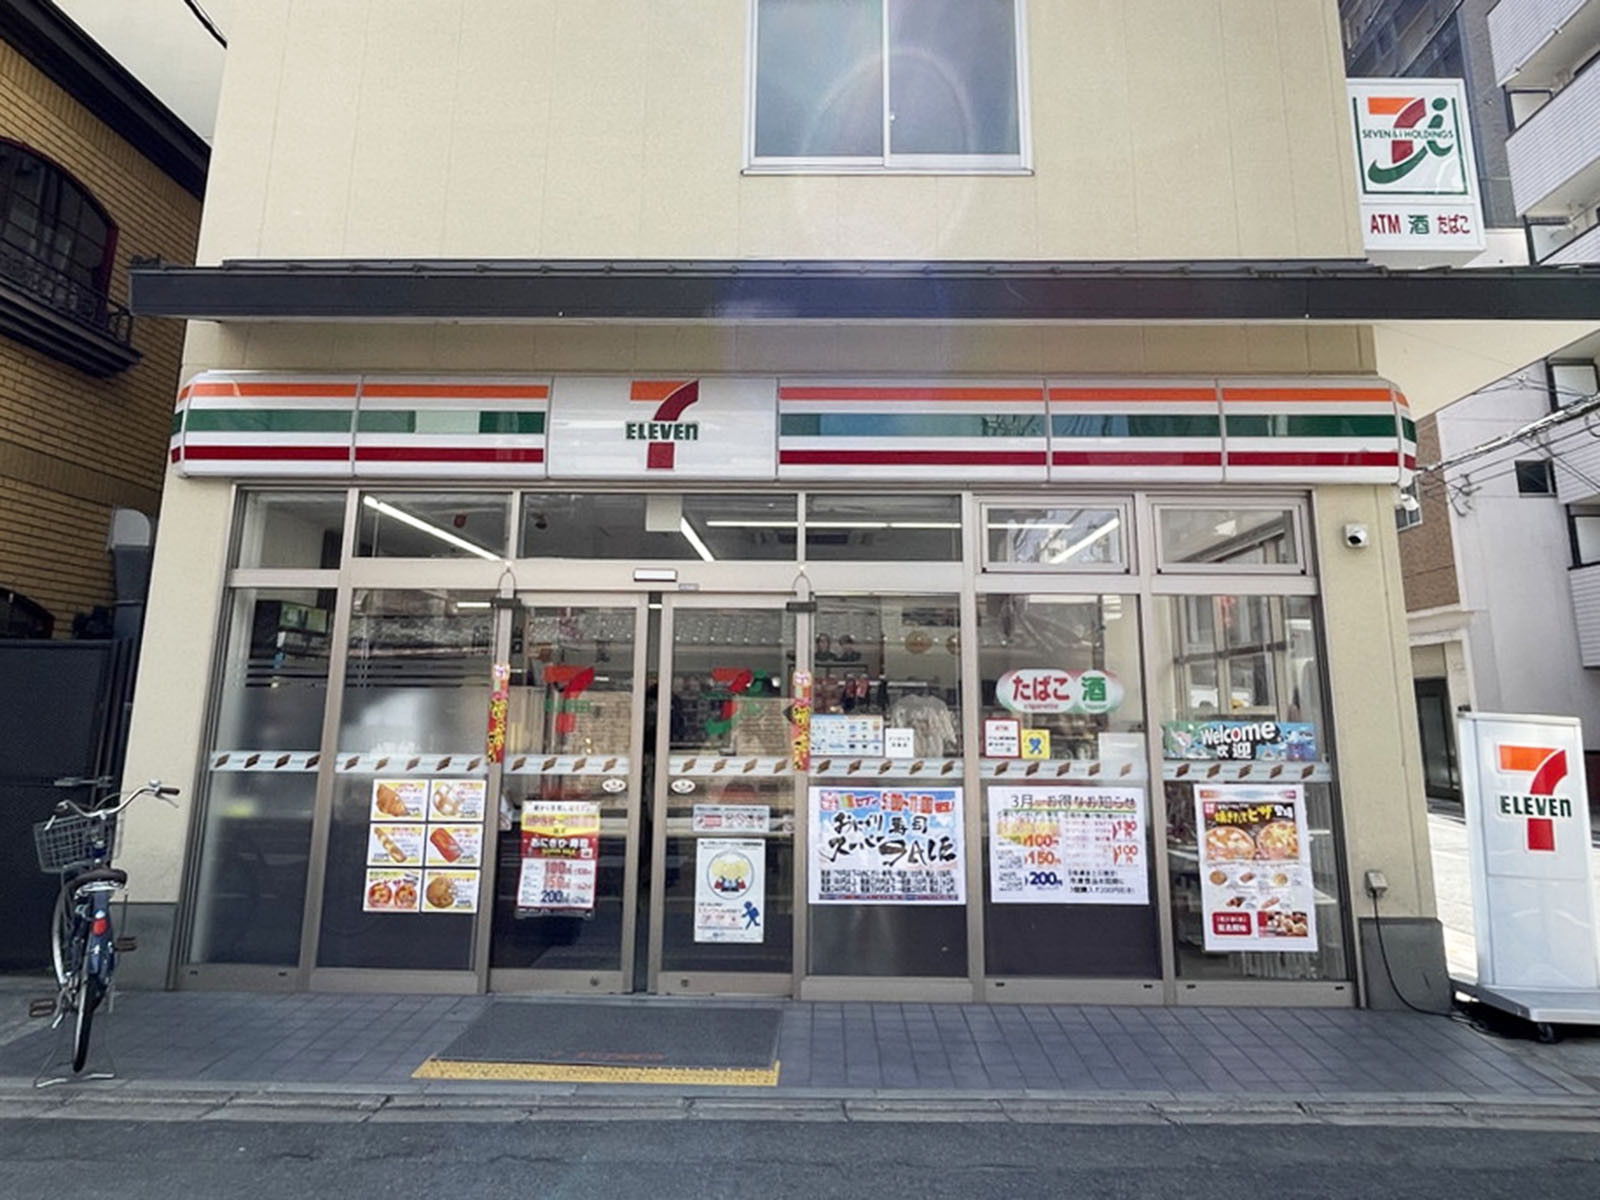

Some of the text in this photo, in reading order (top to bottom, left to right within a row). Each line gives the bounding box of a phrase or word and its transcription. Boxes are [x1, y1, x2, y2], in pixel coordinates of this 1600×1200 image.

[1362, 129, 1391, 139] SEVEN
[1403, 129, 1454, 139] HOLDINGS
[1370, 214, 1402, 234] ATM
[1408, 214, 1431, 235] 酒
[1436, 214, 1471, 235] たばこ
[1012, 675, 1106, 701] たばこ 酒
[1200, 721, 1276, 745] Welcome
